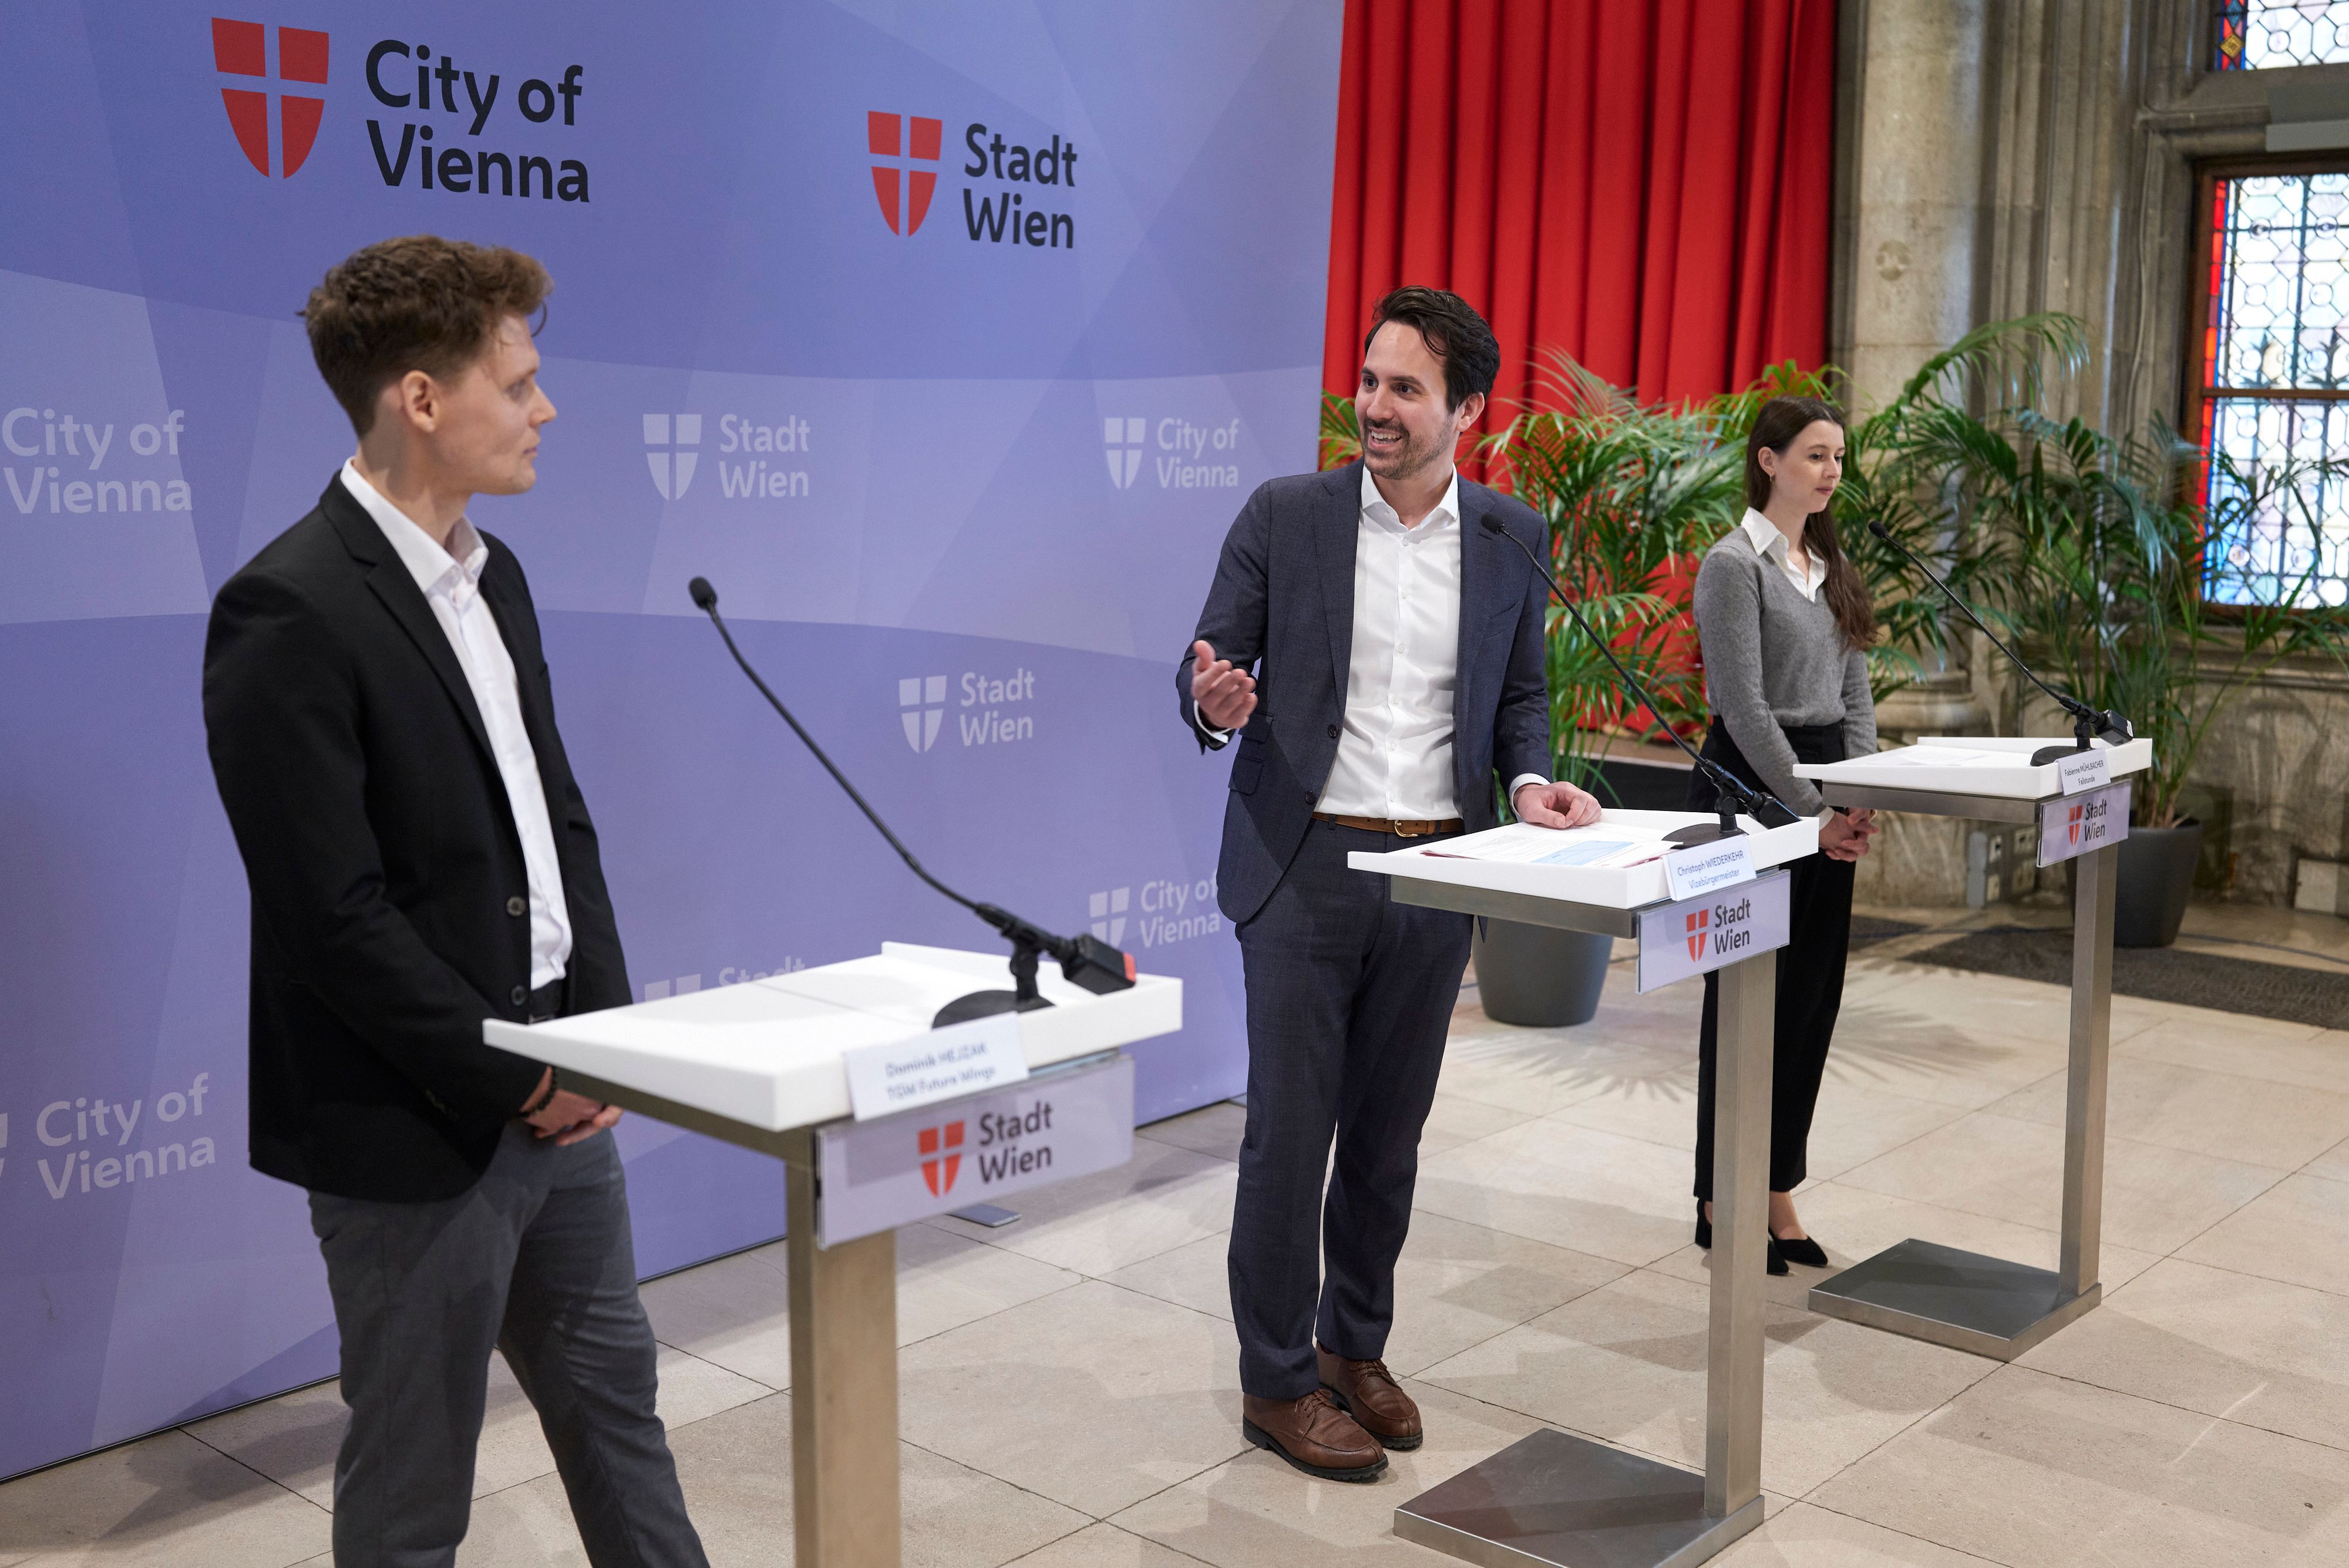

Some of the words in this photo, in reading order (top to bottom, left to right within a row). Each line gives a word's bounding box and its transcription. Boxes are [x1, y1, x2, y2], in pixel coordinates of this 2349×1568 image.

[366, 39, 500, 136] City
[518, 65, 583, 126] of
[366, 119, 590, 203] Vienna
[964, 123, 1078, 187] Stadt
[963, 188, 1074, 249] Wien
[2, 408, 114, 470] City
[129, 409, 184, 456] of
[719, 413, 811, 453] Stadt
[1157, 417, 1208, 459] City
[1213, 418, 1240, 450] of
[3, 466, 193, 514] Vienna
[719, 460, 809, 498] Wien
[1156, 456, 1239, 489] Vienna
[960, 667, 1035, 708] Stadt
[960, 710, 1034, 747] Wien
[2064, 768, 2081, 776] Fabienne
[2079, 760, 2104, 773] MÜHLBACHER
[2078, 775, 2095, 786] Failstunde
[2085, 799, 2107, 820] Stadt
[2085, 822, 2105, 842] Wien
[1677, 860, 1706, 877] Christoph
[1705, 850, 1744, 869] WIEDERKEHR
[1688, 869, 1739, 889] Vizebürgermeister
[1140, 880, 1190, 916] City
[1715, 898, 1751, 928] Stadt
[1139, 912, 1221, 948] Vienna
[1715, 928, 1750, 955] Wien
[885, 1055, 936, 1078] Dominik
[919, 1076, 958, 1094] Future
[36, 1097, 142, 1146] City
[156, 1072, 209, 1122] of
[979, 1099, 1053, 1147] Stadt
[38, 1136, 216, 1199] Vienna
[978, 1145, 1052, 1184] Wien
